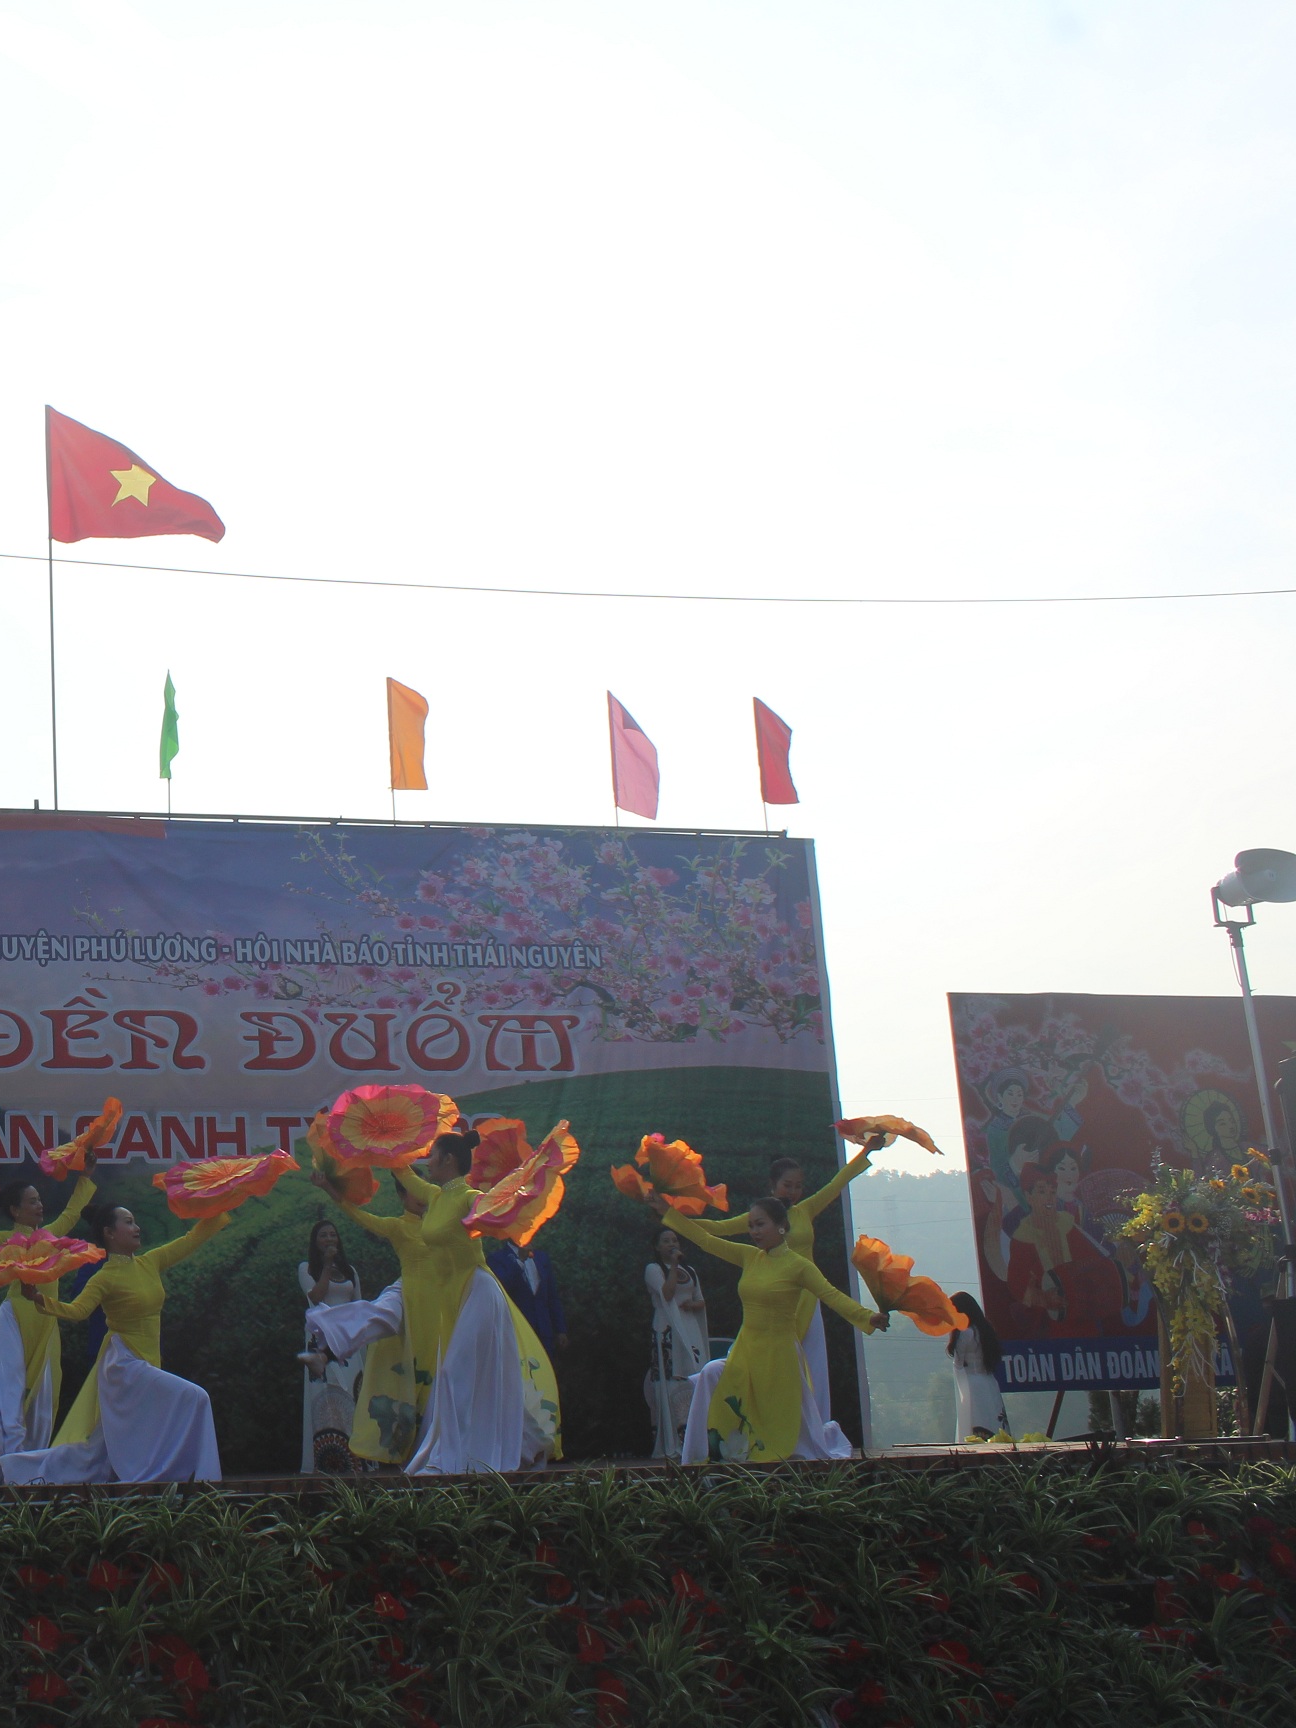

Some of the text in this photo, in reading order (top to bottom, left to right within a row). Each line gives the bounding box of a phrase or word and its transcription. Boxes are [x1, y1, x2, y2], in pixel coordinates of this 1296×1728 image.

[74, 930, 128, 961] PHÚ
[133, 934, 216, 962] LƯƠNG
[236, 933, 280, 968] HỘI
[286, 934, 338, 963] NHÀ
[342, 935, 391, 965] BÁO
[393, 937, 449, 966] TỈNH
[454, 937, 504, 967] THÁI
[511, 939, 602, 968] NGUYÊN
[1001, 1347, 1056, 1384] TOÀN
[1060, 1346, 1103, 1382] DÂN
